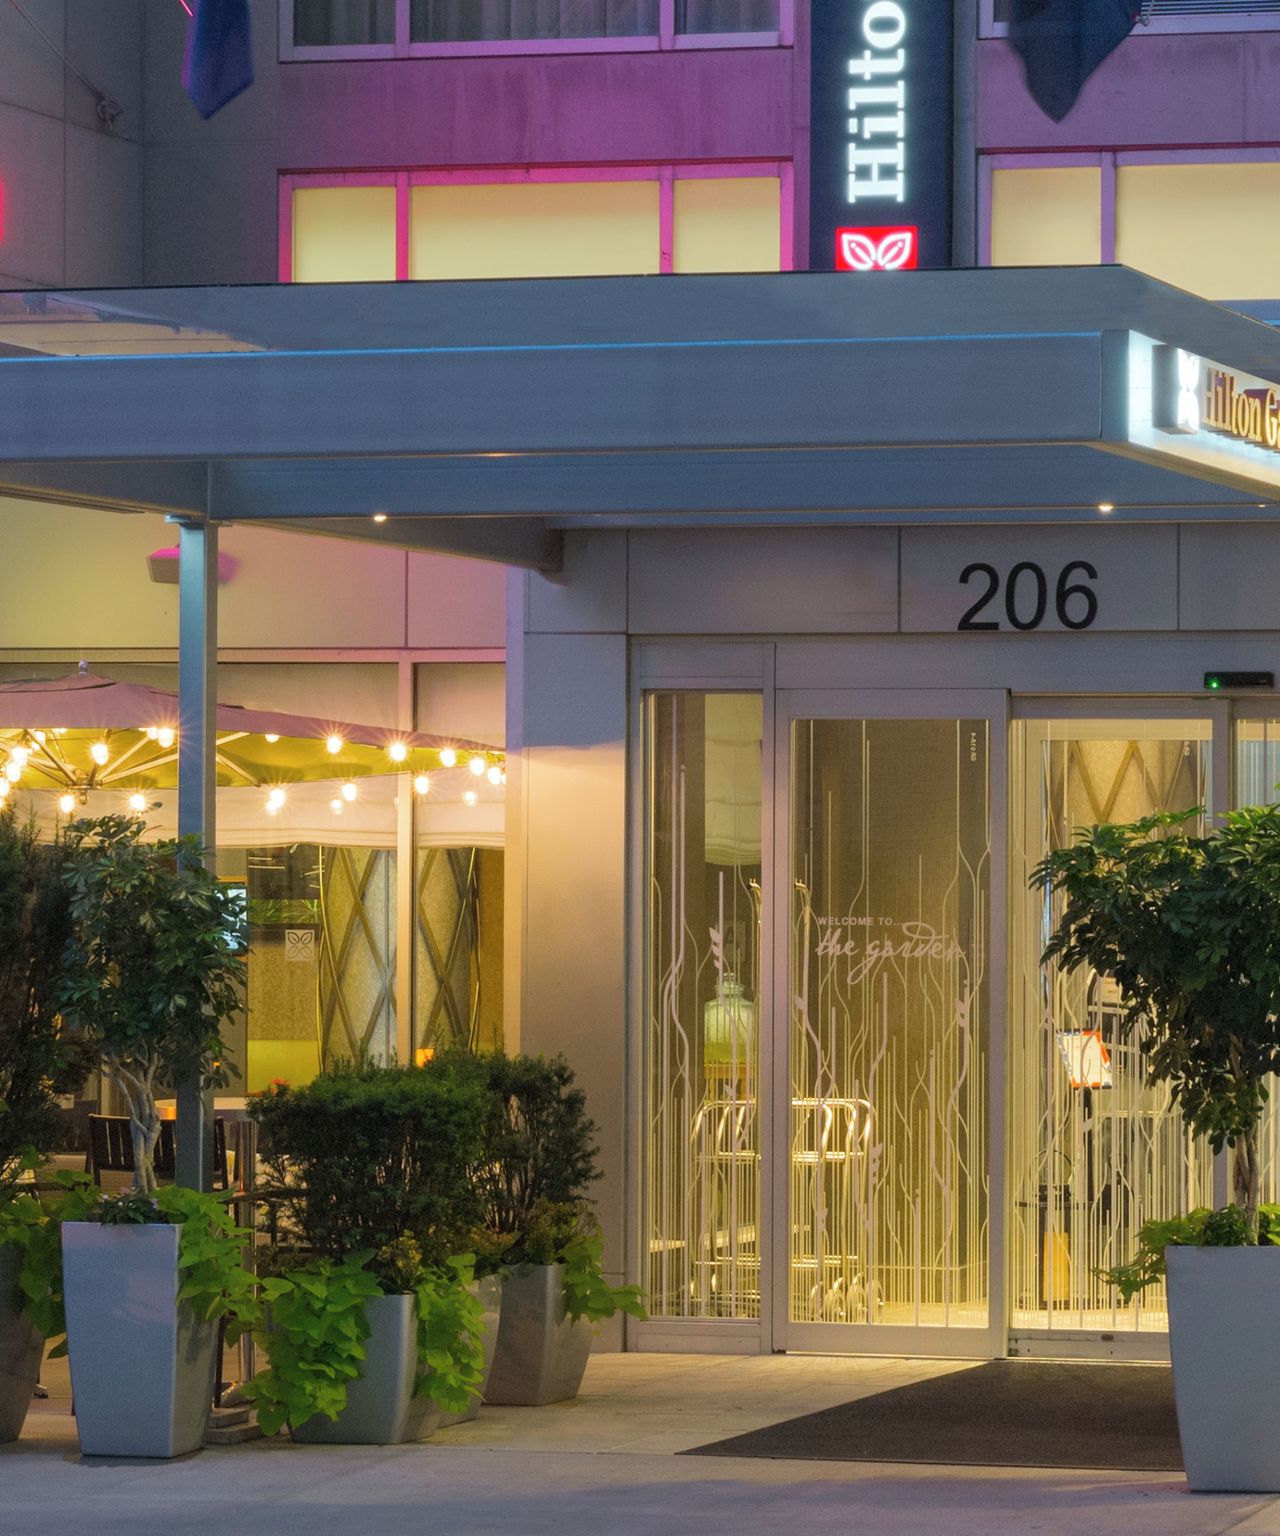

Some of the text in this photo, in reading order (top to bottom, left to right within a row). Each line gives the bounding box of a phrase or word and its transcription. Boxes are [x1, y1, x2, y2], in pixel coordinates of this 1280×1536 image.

[1202, 366, 1263, 443] Hilton
[957, 560, 1098, 631] 206
[814, 921, 966, 986] the garden
[818, 916, 874, 927] WELCOME
